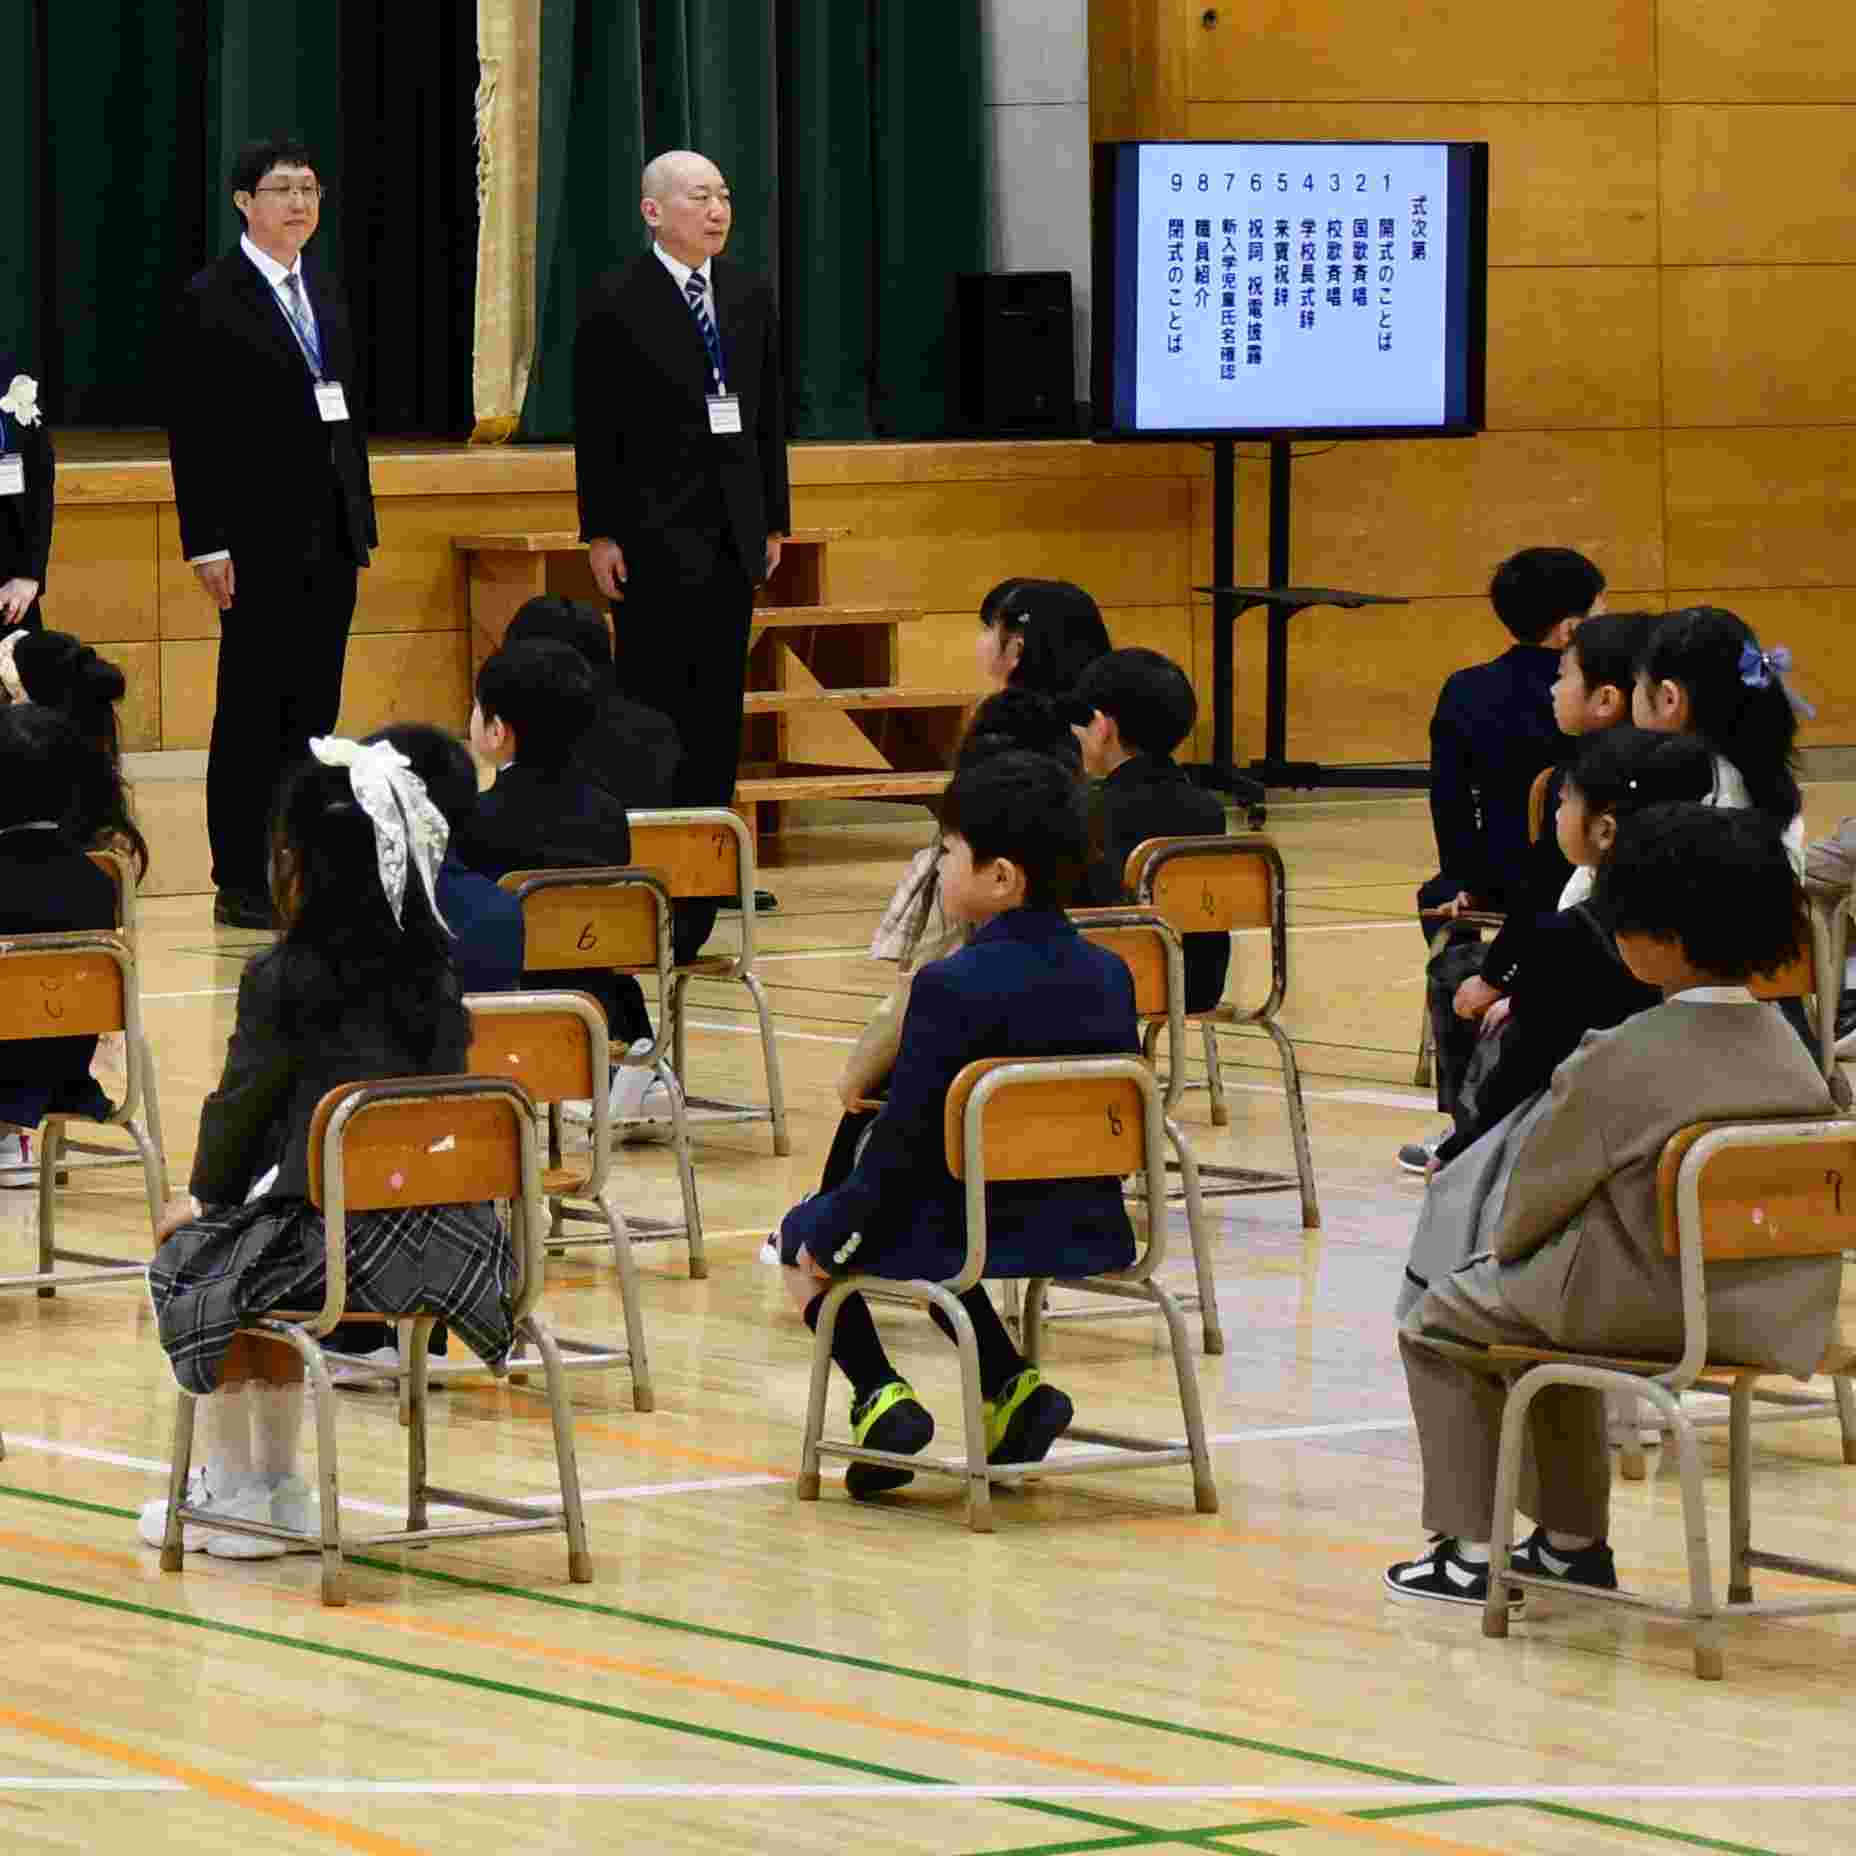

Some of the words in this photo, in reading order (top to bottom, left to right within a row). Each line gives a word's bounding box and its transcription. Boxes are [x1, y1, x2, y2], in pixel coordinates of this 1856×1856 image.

[1170, 172, 1183, 193] 9
[1197, 172, 1209, 193] 8
[1223, 172, 1235, 193] 7
[1249, 172, 1262, 193] 6
[1277, 172, 1289, 193] 5
[1302, 172, 1314, 193] 4
[1328, 172, 1341, 193] 3
[1355, 172, 1367, 193] 2
[1383, 172, 1391, 193] 1
[1411, 195, 1428, 261] 式次第
[1194, 218, 1211, 309] 職員紹介
[1273, 218, 1289, 307] 来賓祝辞
[1299, 218, 1316, 329] 学校長式辞
[1326, 218, 1342, 307] 校歌斉唱
[1352, 218, 1369, 307] 国歌斉唱
[1167, 218, 1184, 354] 閉式のことば
[1378, 218, 1395, 352] 開式のことば
[577, 920, 598, 951] 6
[1824, 1168, 1844, 1213] 7
